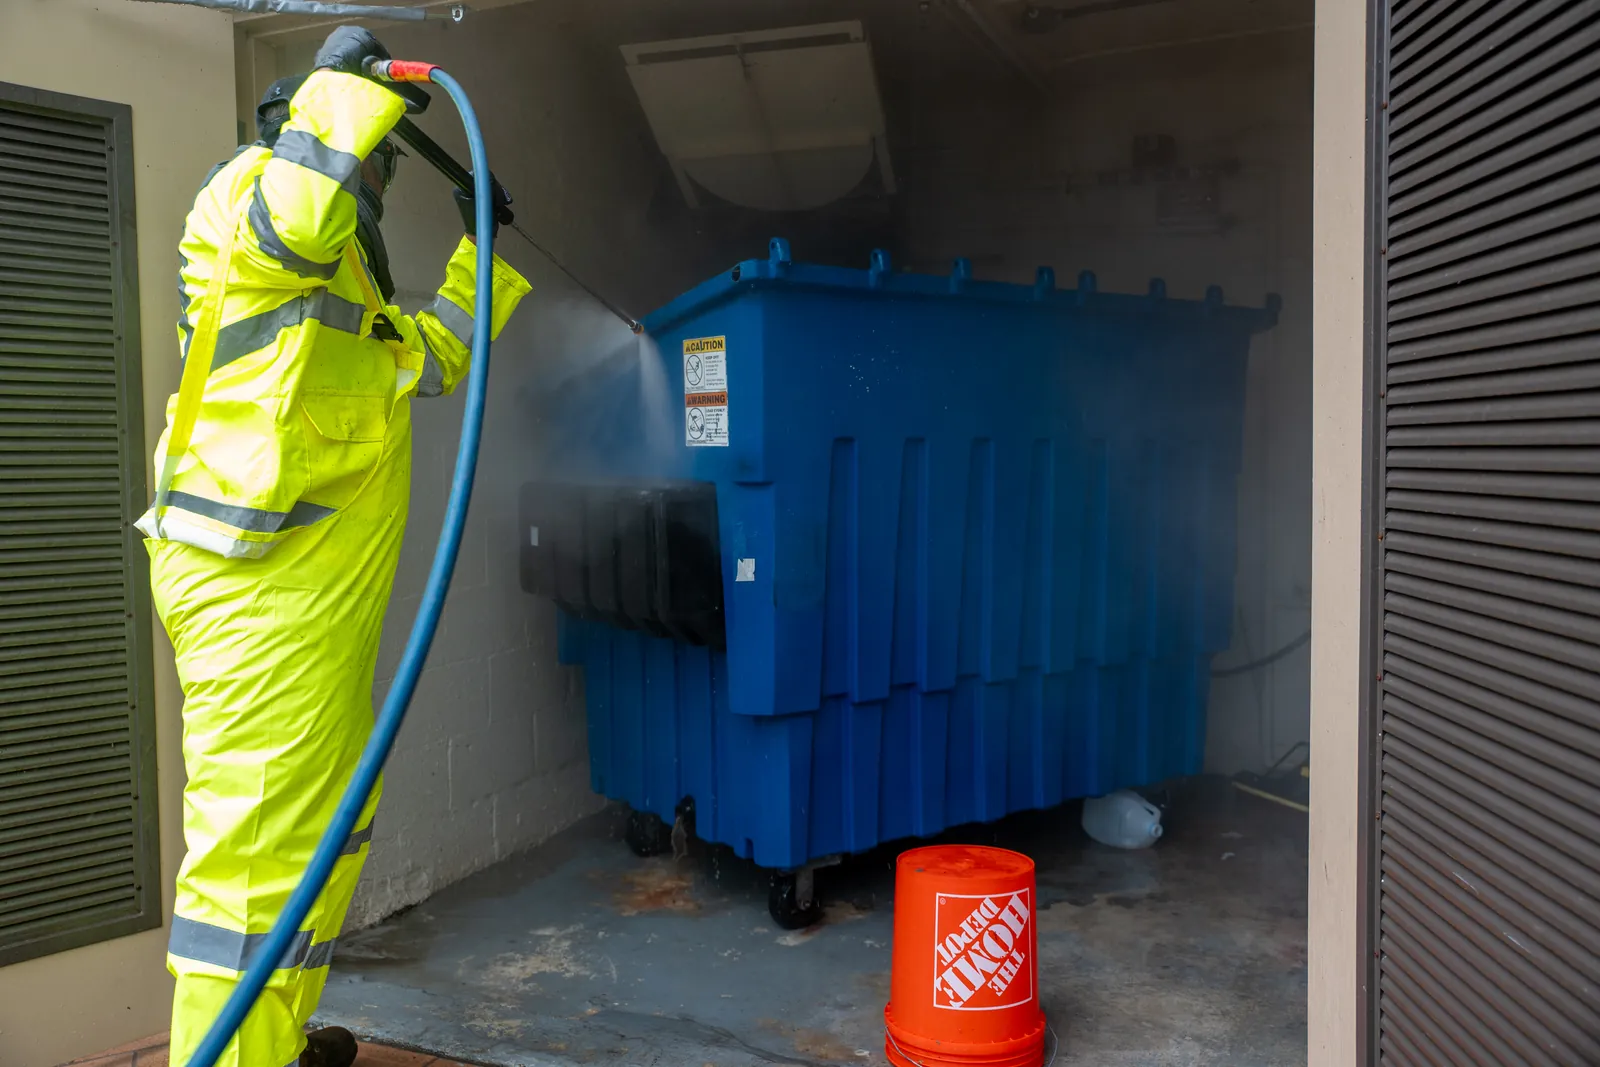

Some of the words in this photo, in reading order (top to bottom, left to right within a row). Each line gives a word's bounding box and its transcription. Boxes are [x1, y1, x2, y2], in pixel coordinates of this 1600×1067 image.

[690, 339, 723, 351] CAUTION
[690, 394, 725, 404] WARNING
[935, 894, 1029, 1008] HOME
[937, 896, 1000, 966] DEPOT
[987, 948, 1025, 996] THE
